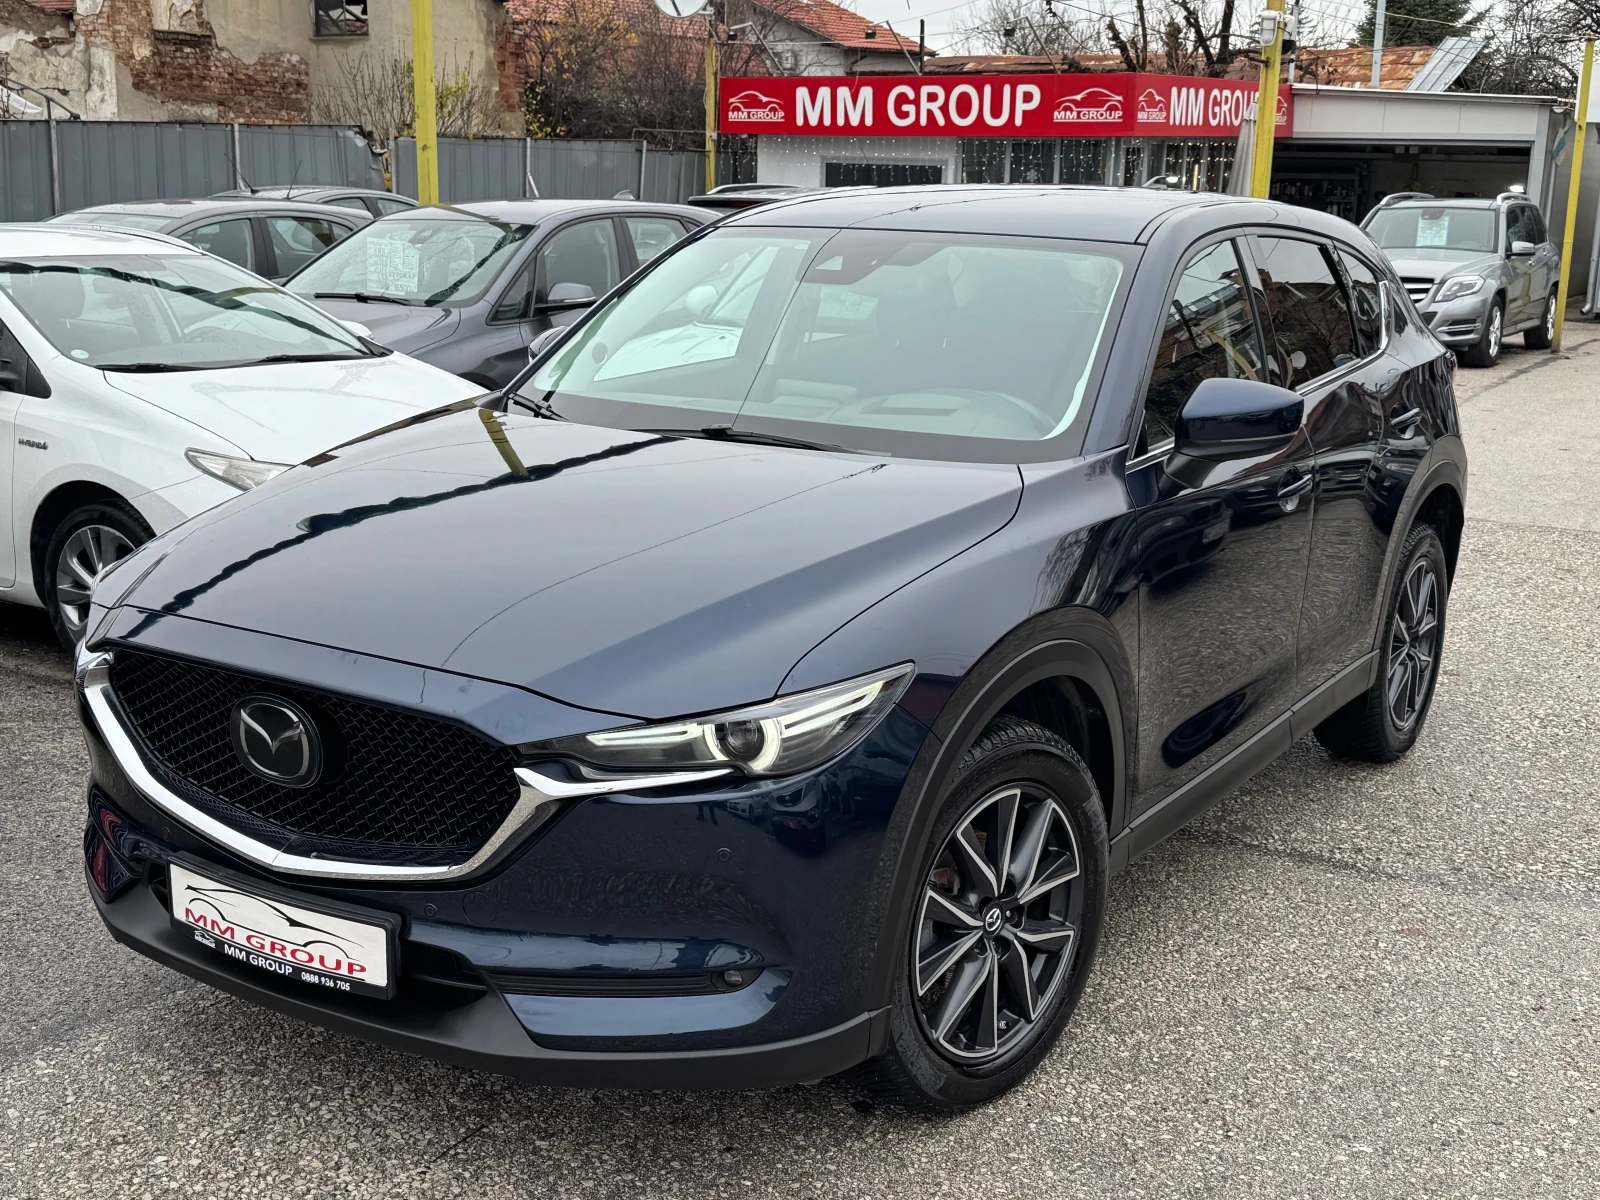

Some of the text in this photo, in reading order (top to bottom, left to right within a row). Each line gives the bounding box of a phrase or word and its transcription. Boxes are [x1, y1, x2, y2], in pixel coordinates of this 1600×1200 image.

[728, 111, 785, 120] MM GROUP
[795, 83, 1042, 127] MM GROUP
[1053, 110, 1123, 120] MM GROUP
[1137, 111, 1167, 120] MM GROUP
[1169, 86, 1260, 127] MM GROU
[184, 906, 367, 976] MM GROUP
[224, 943, 351, 991] MM GROUP 0888 936 705
